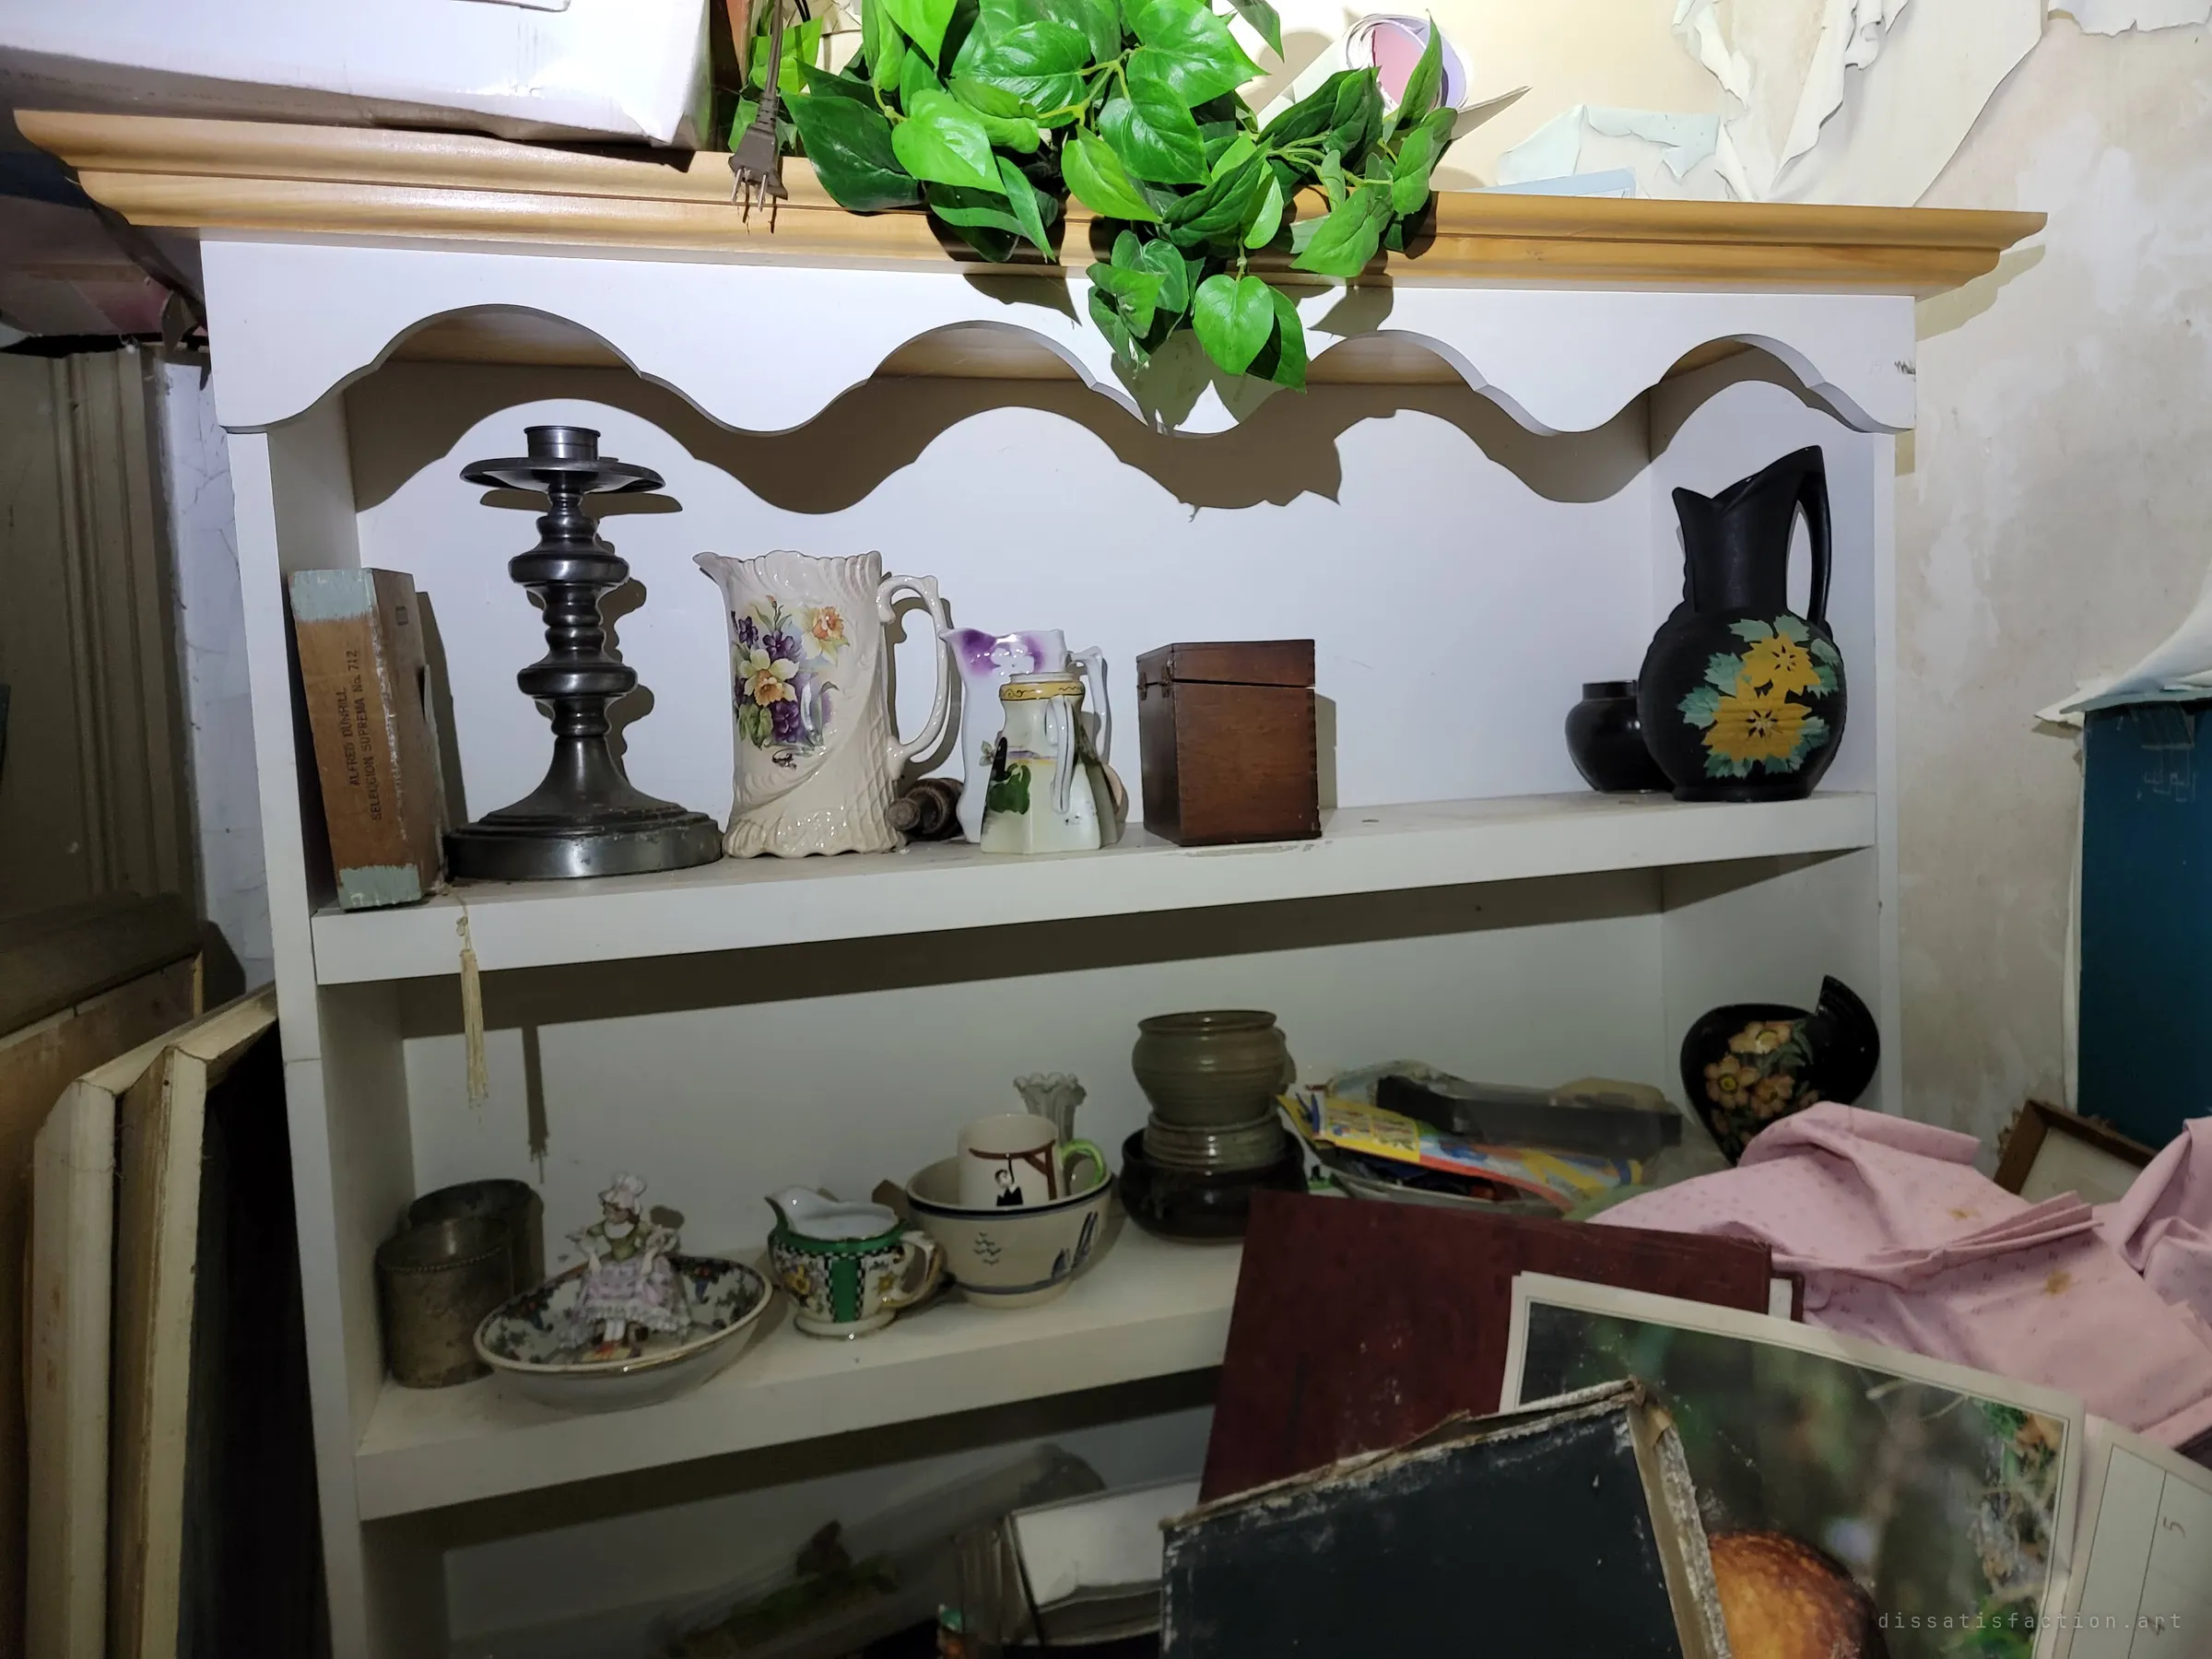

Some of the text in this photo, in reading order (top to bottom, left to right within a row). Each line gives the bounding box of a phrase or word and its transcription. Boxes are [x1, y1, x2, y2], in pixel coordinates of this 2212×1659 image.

[345, 649, 359, 672] 712
[335, 685, 361, 785] ALFRED DUNHILL
[353, 697, 372, 752] SUPREMA
[362, 756, 382, 820] SELECCION
